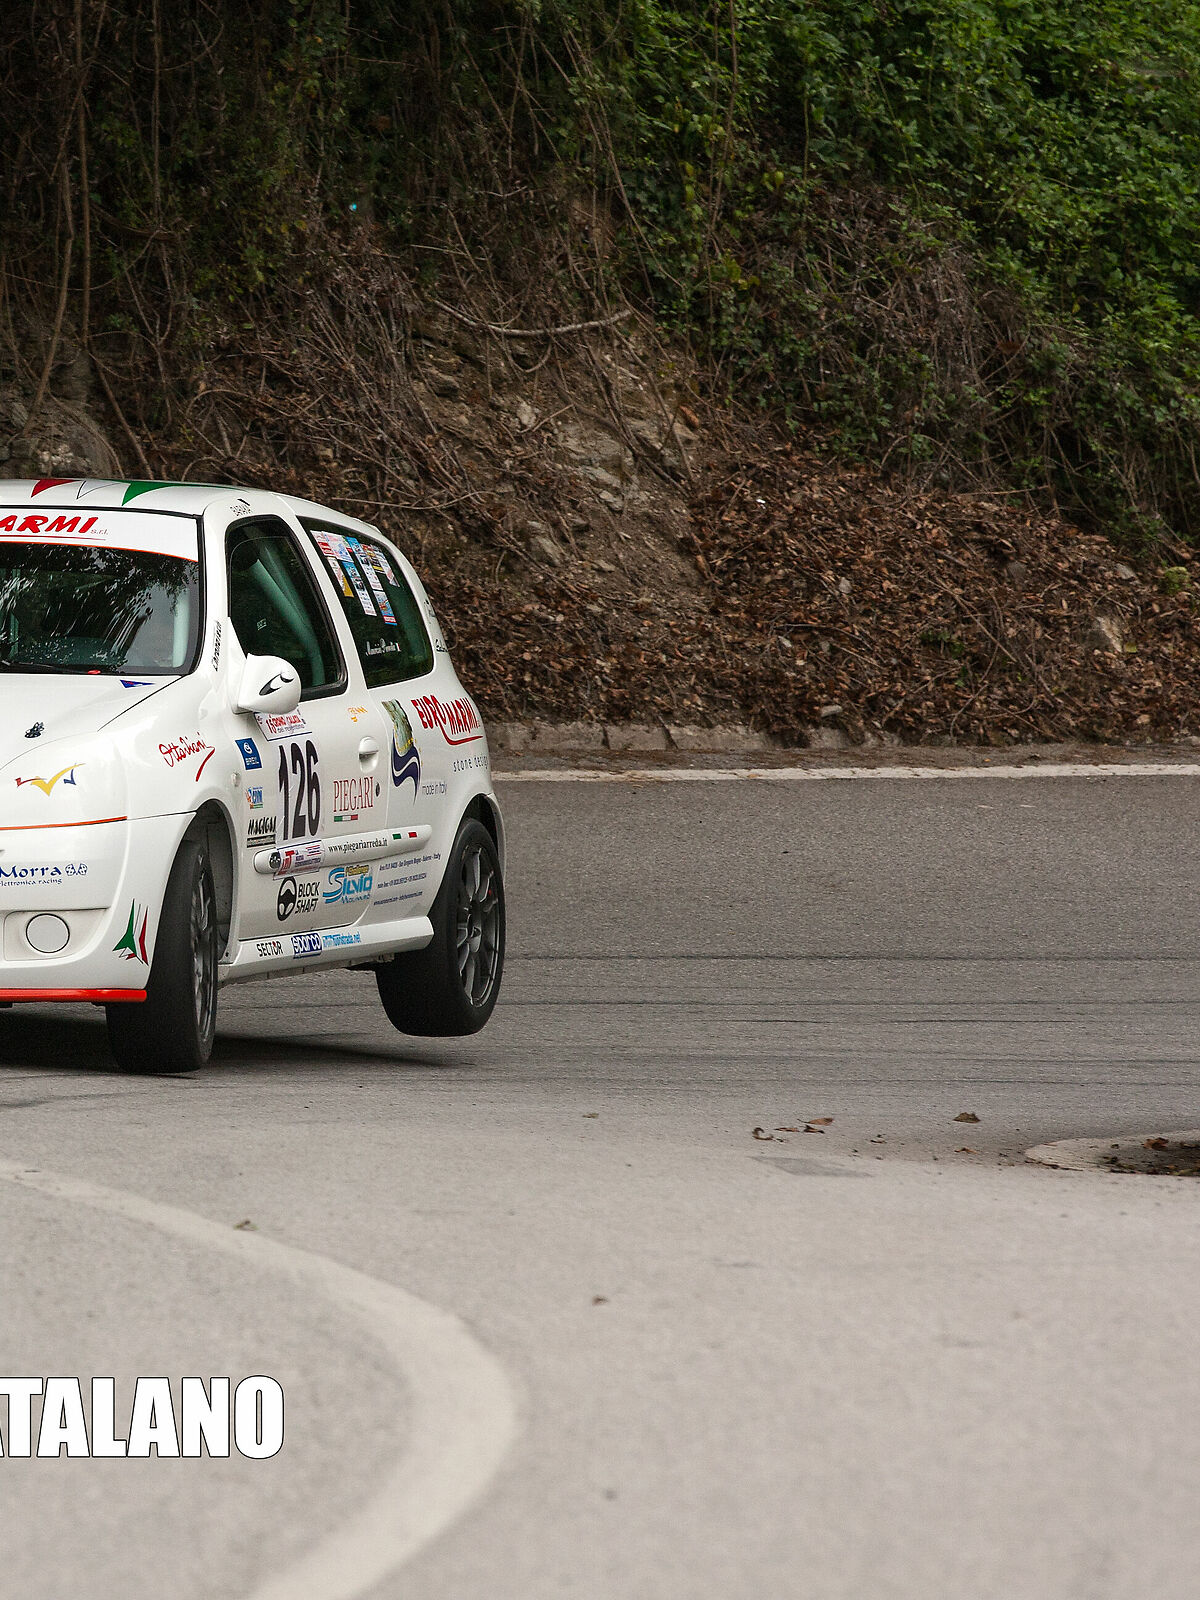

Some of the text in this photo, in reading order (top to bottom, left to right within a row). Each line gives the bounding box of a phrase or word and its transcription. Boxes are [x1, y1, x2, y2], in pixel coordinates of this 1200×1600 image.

[453, 758, 473, 772] stone
[278, 739, 321, 840] 126
[333, 777, 374, 812] PIEGARI
[328, 838, 388, 854] www.piegariarreda.it
[298, 882, 320, 898] BLOCK
[295, 898, 319, 914] SHAFT
[256, 940, 284, 957] SECTOR
